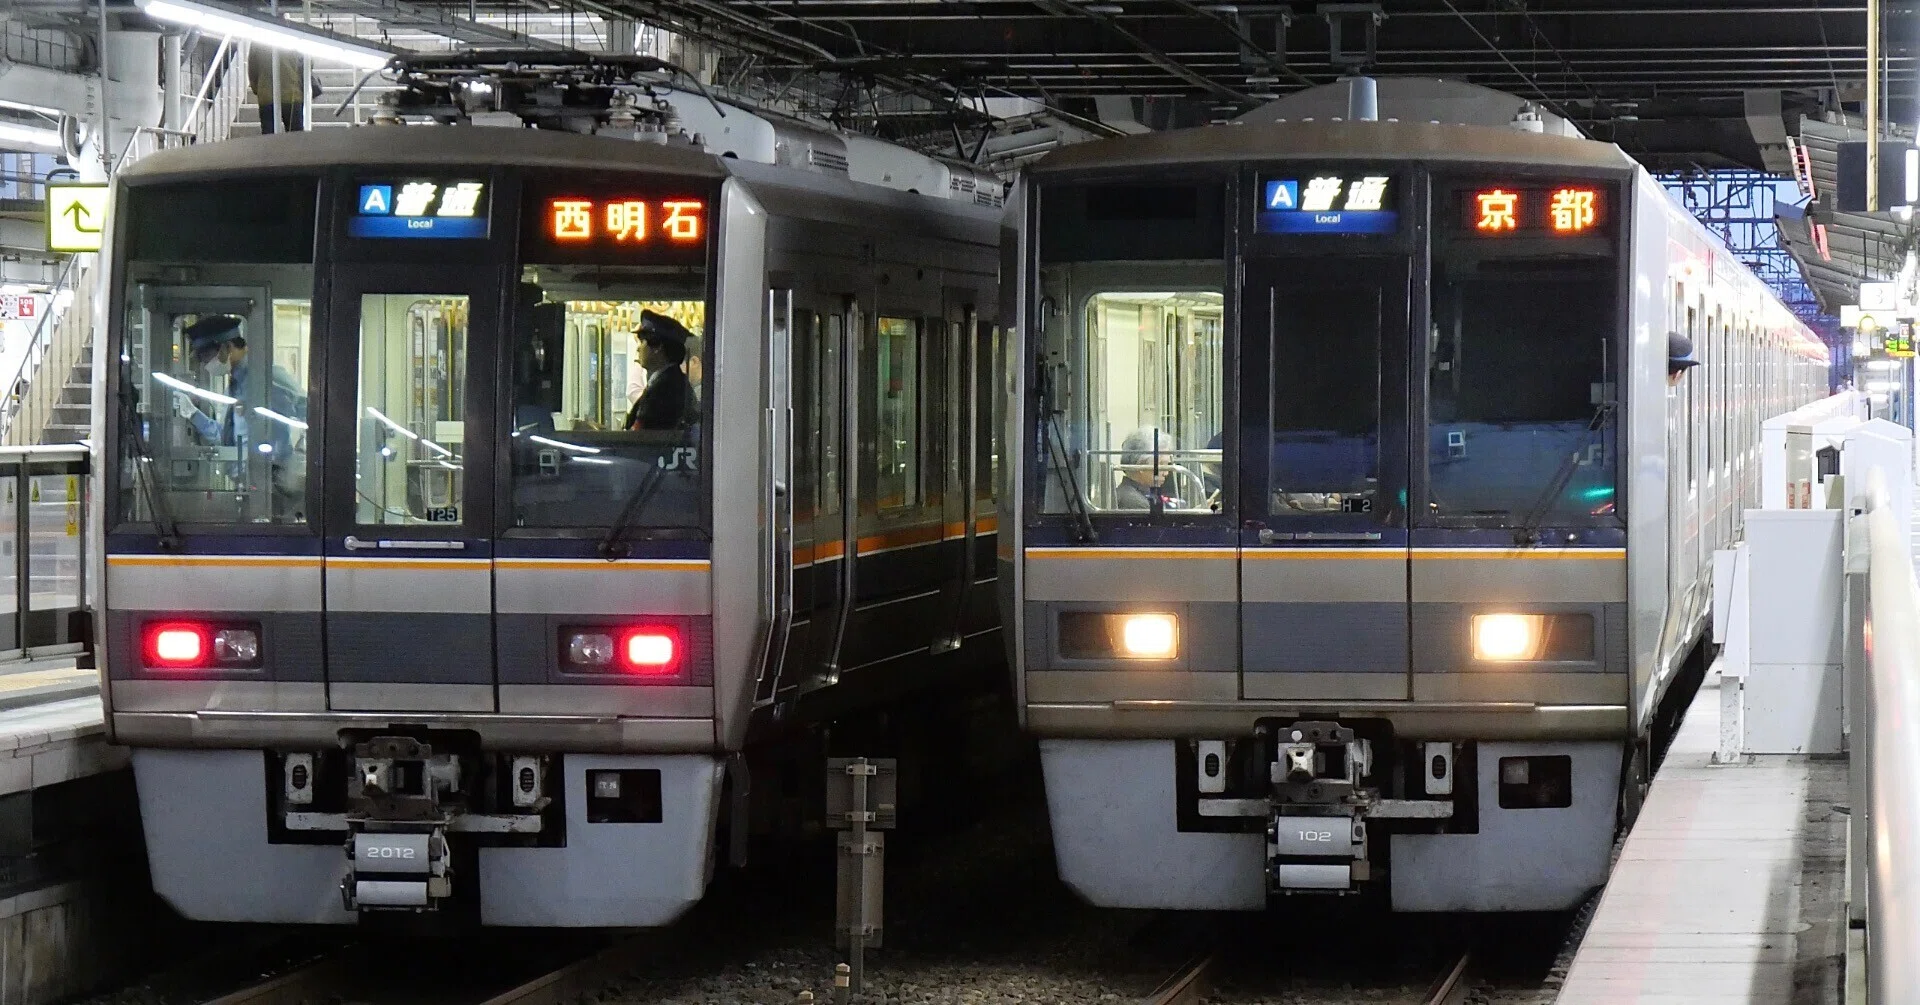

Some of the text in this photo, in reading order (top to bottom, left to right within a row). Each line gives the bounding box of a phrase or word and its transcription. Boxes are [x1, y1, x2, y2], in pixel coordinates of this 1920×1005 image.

[364, 188, 386, 211] A
[395, 182, 483, 216] 普通
[1270, 184, 1293, 207] A
[1302, 176, 1389, 210] 普通
[553, 201, 702, 240] 西明石
[1315, 214, 1341, 223] Local
[1477, 189, 1594, 230] 京都
[407, 219, 433, 229] Local
[657, 446, 698, 470] JR
[428, 508, 456, 521] T25
[1342, 499, 1371, 512] H 2
[1298, 830, 1331, 842] 102
[367, 847, 415, 859] 2012
